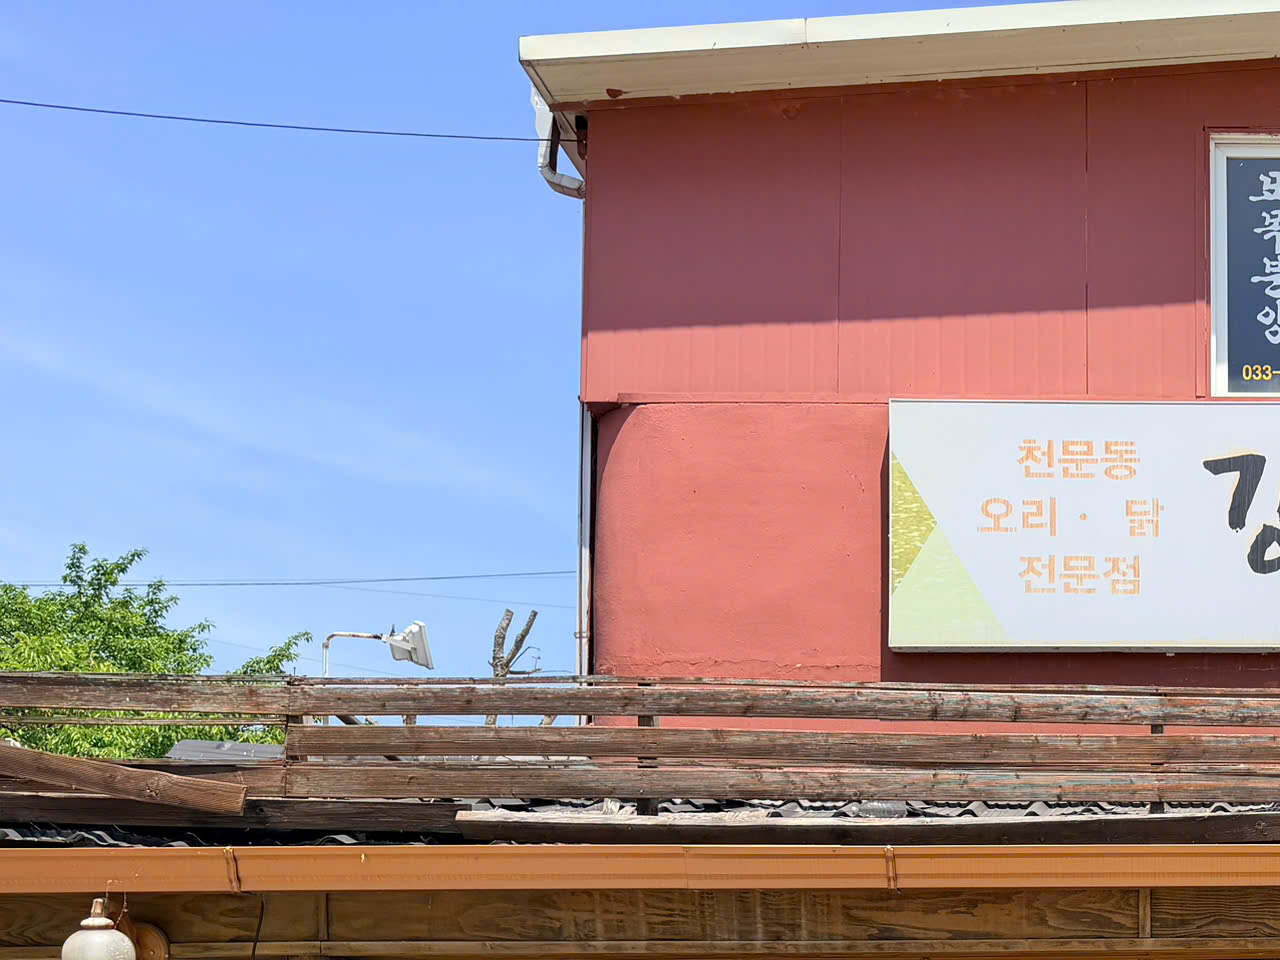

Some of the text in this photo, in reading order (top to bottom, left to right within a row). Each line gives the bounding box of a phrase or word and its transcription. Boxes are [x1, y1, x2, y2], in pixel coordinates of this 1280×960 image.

[1017, 440, 1141, 480] 천문동
[977, 497, 1057, 536] 오리
[1125, 498, 1165, 537] 닭
[1018, 555, 1140, 595] 전문점
